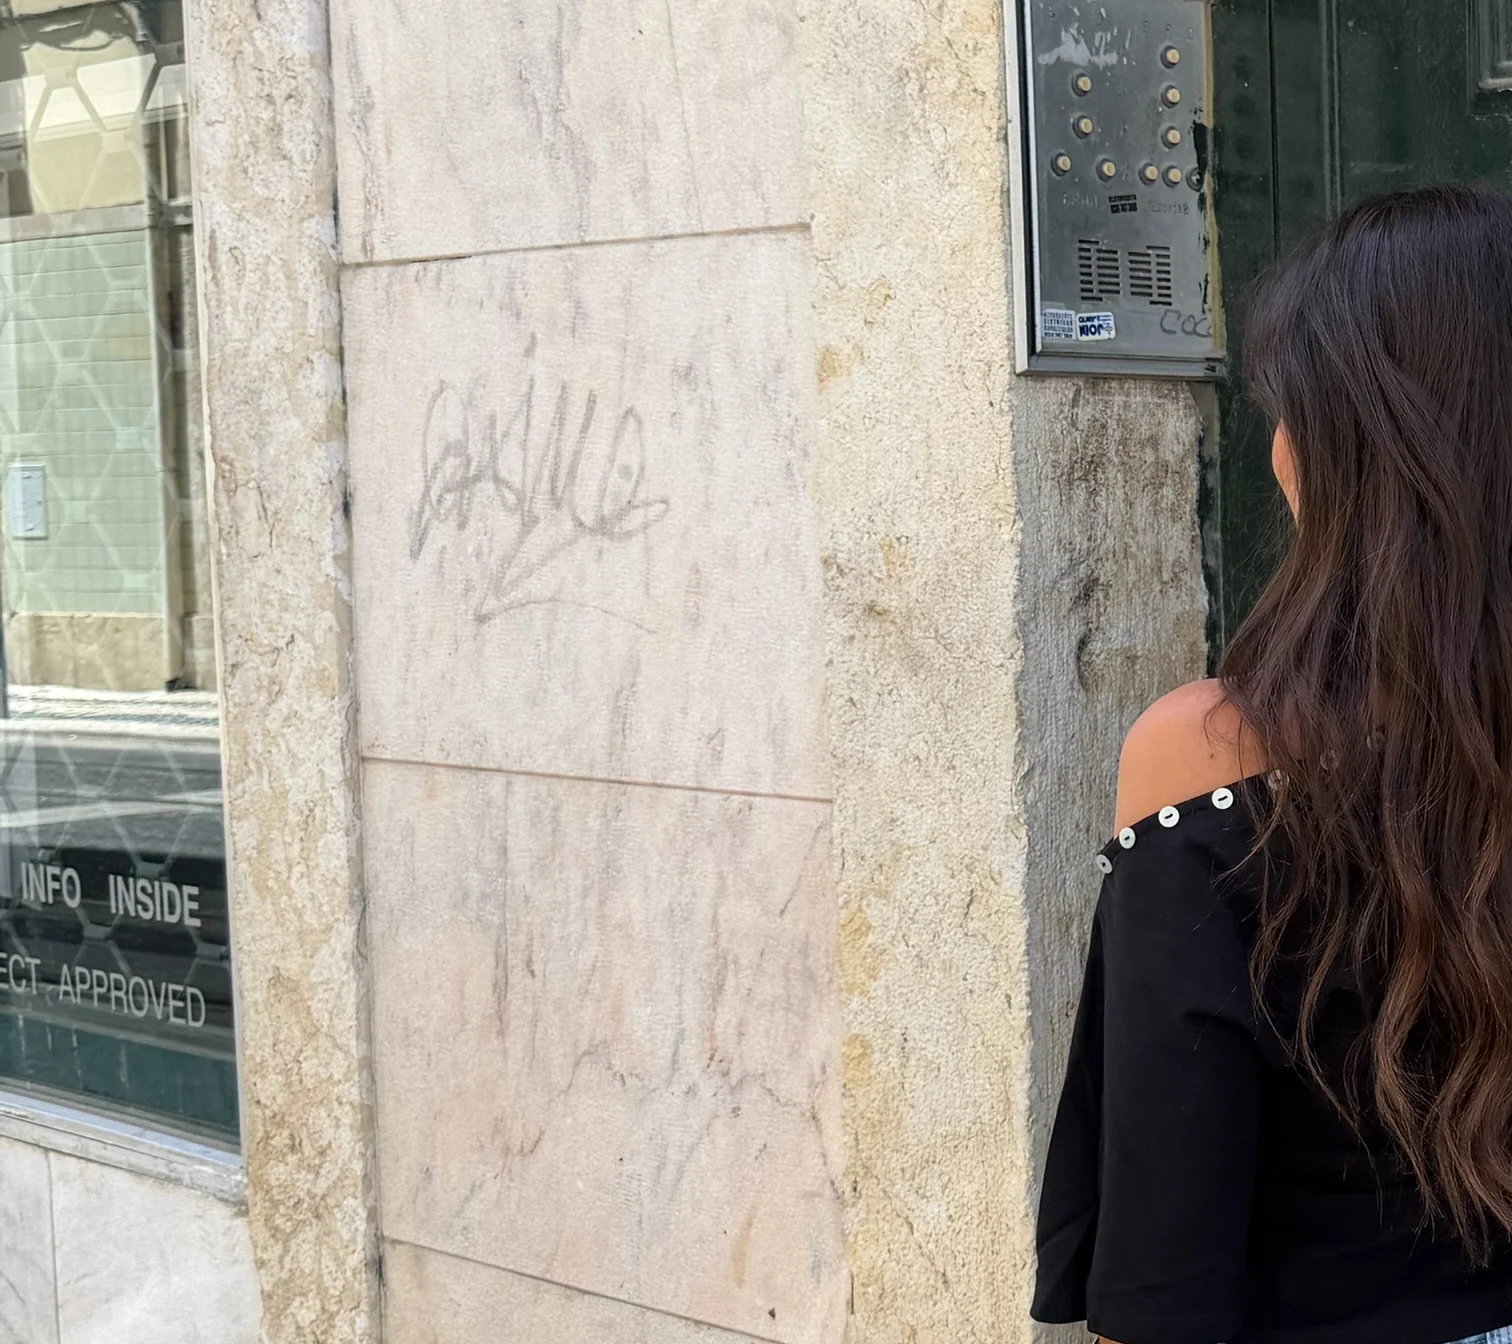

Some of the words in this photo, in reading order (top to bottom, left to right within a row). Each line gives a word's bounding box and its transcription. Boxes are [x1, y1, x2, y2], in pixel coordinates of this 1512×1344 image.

[21, 863, 81, 908] INFO
[109, 874, 202, 927] INSIDE
[59, 964, 206, 1027] APPROVED
